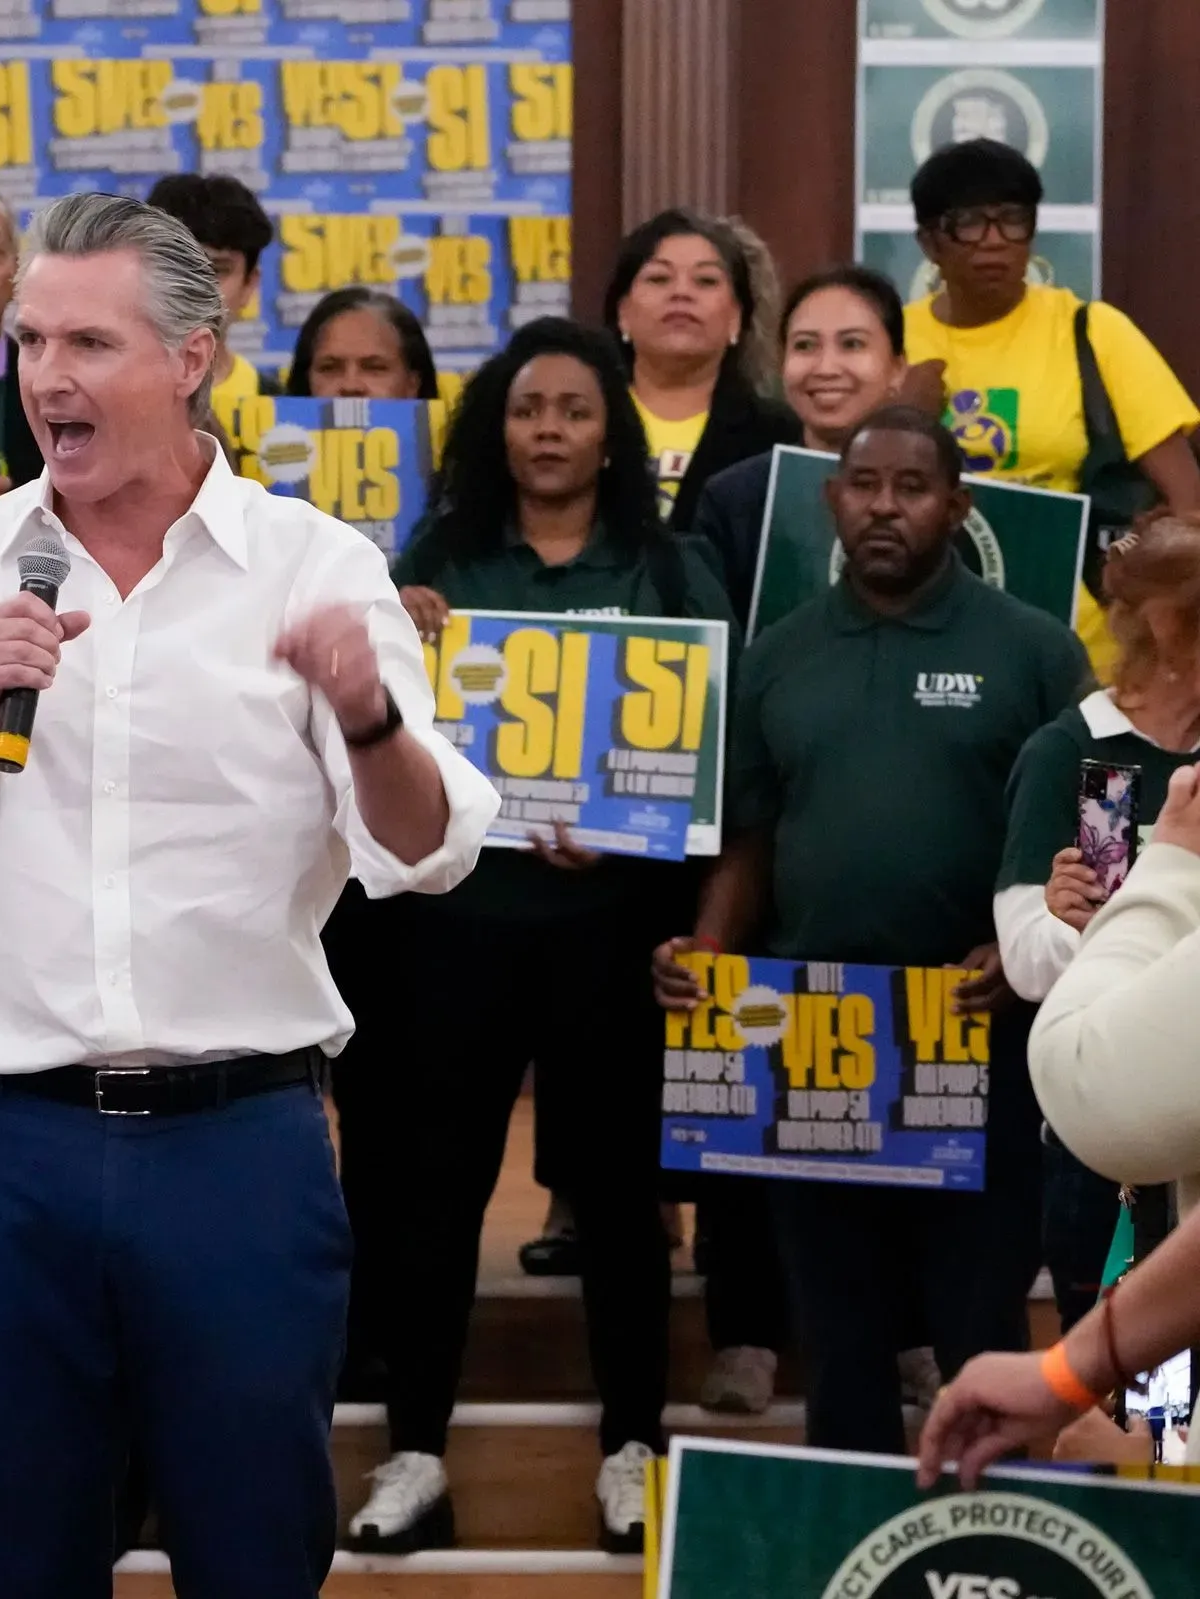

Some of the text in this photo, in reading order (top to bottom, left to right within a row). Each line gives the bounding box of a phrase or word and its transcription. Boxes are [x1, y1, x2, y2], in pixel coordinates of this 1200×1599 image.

[306, 427, 399, 521] YES
[496, 627, 591, 779] SI
[621, 636, 711, 751] SI
[916, 672, 978, 693] UDW
[780, 994, 876, 1089] YES
[949, 1502, 1081, 1546] PROTECT
[1076, 1538, 1128, 1590] OUR
